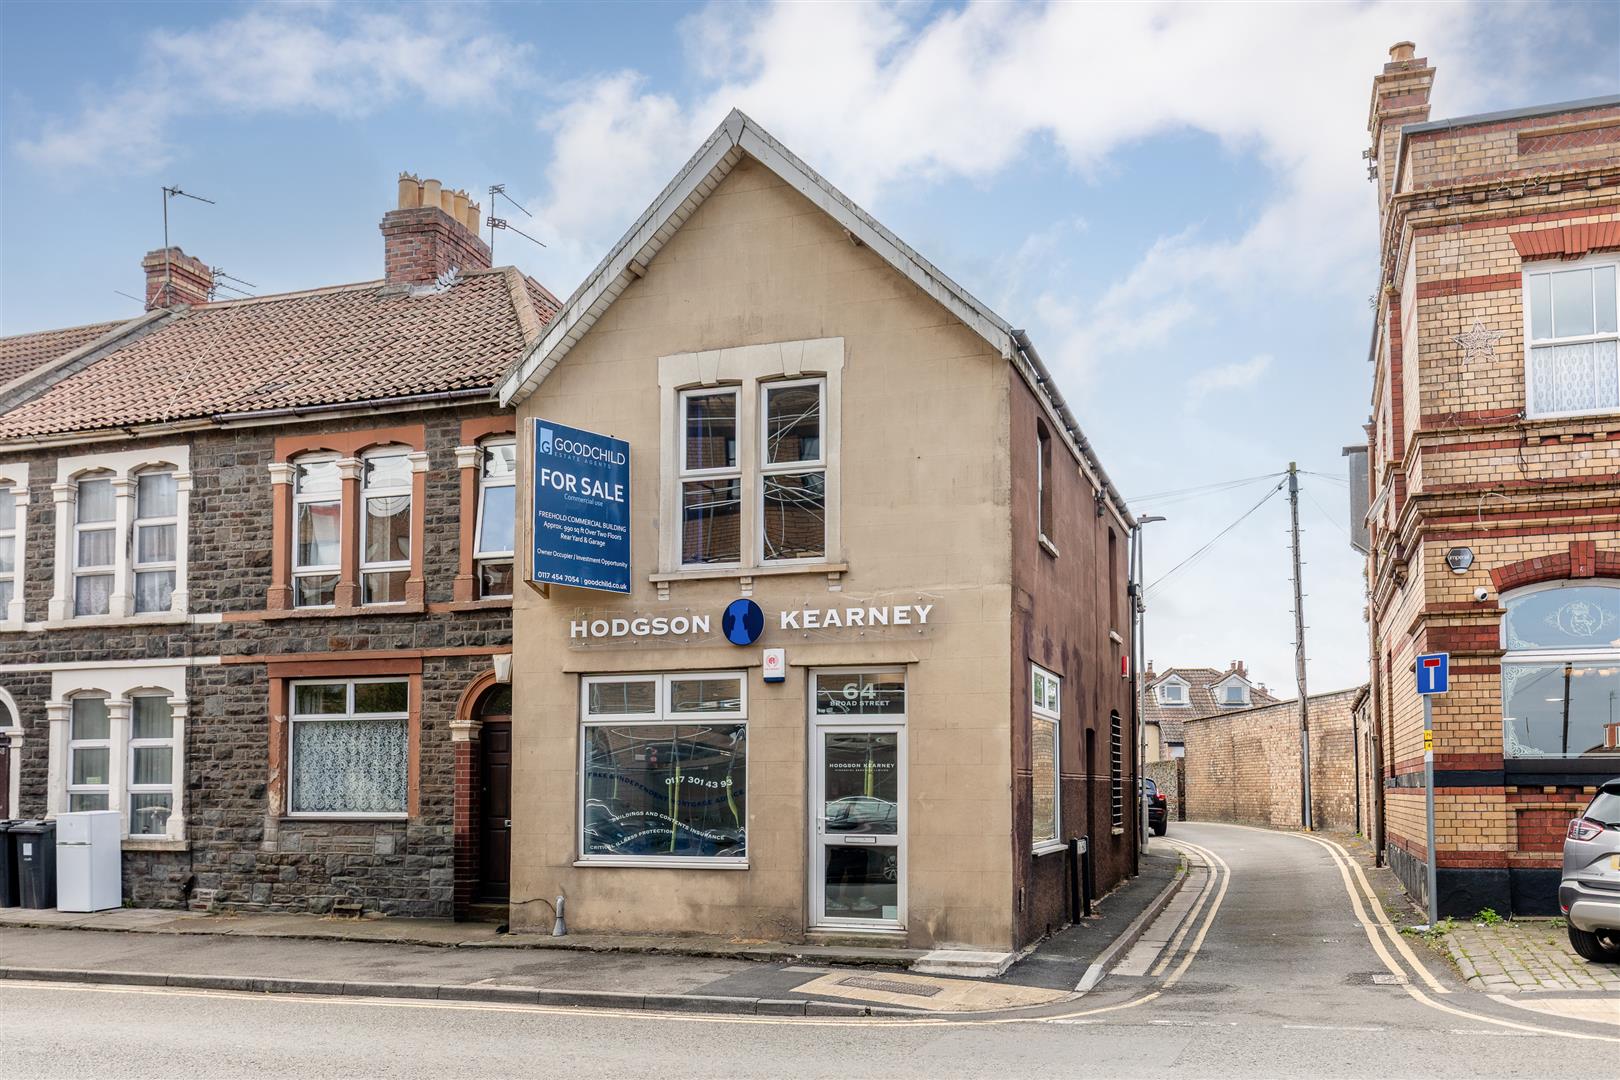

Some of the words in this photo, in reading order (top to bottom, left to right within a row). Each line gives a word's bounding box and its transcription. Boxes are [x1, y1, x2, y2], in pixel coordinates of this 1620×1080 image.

[554, 438, 626, 464] GOODCHILD
[554, 452, 580, 462] ESTATE
[584, 459, 612, 470] AGENTS
[542, 468, 577, 492] FOR
[581, 477, 624, 502] SALE
[564, 493, 594, 505] Commercial
[538, 510, 567, 521] FREEHOLD
[568, 516, 602, 528] COMMERCIAL
[602, 522, 626, 532] BUILDING
[544, 521, 562, 530] Approx.
[585, 528, 596, 536] Over
[597, 530, 607, 538] Two
[608, 532, 622, 540] Floors
[572, 534, 582, 542] Yard
[588, 537, 606, 548] Garage
[536, 548, 552, 556] Owner
[552, 550, 573, 560] Occupier
[576, 554, 600, 564] Investment
[600, 558, 628, 568] Opportunity
[564, 574, 580, 582] 7054
[584, 578, 628, 590] goodchild.co.uk
[570, 615, 710, 638] HODGSON
[780, 605, 934, 630] KEARNEY
[842, 682, 876, 700] 64
[665, 776, 685, 784] 0117
[688, 776, 704, 786] 301
[720, 778, 733, 788] 93
[638, 828, 674, 836] PROTECTION
[660, 813, 690, 830] CONTENTS
[690, 827, 725, 840] INSURANCE
